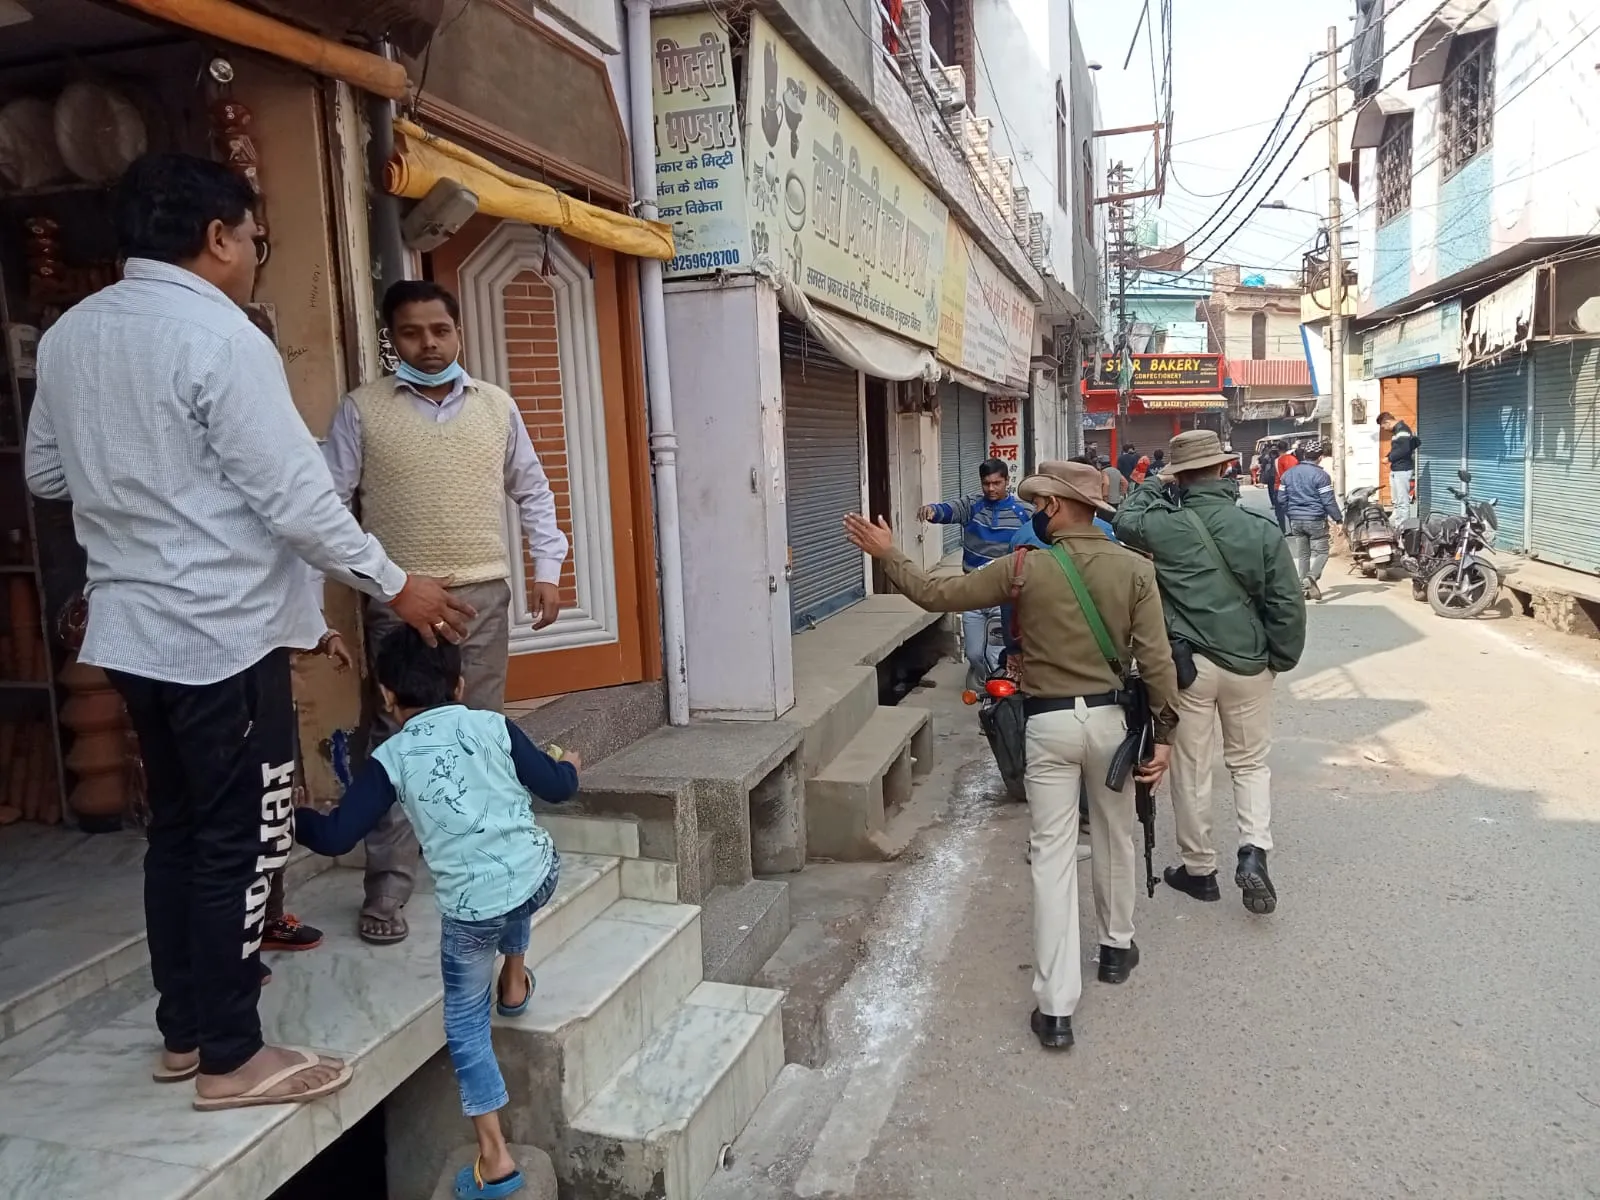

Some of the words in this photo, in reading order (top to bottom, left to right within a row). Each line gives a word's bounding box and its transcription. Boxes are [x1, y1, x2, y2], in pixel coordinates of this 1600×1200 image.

[656, 160, 683, 174] कार
[686, 156, 698, 170] के
[656, 181, 675, 196] र्तन
[678, 179, 690, 193] के
[693, 177, 719, 192] थोक
[657, 205, 683, 218] टकर
[685, 200, 723, 215] विक्रेता
[1106, 358, 1142, 372] STR
[1150, 358, 1200, 371] BAKERY
[1135, 372, 1182, 380] CONFECTIONERY
[990, 418, 1018, 440] मूर्ति
[989, 442, 1019, 461] केन्द्र
